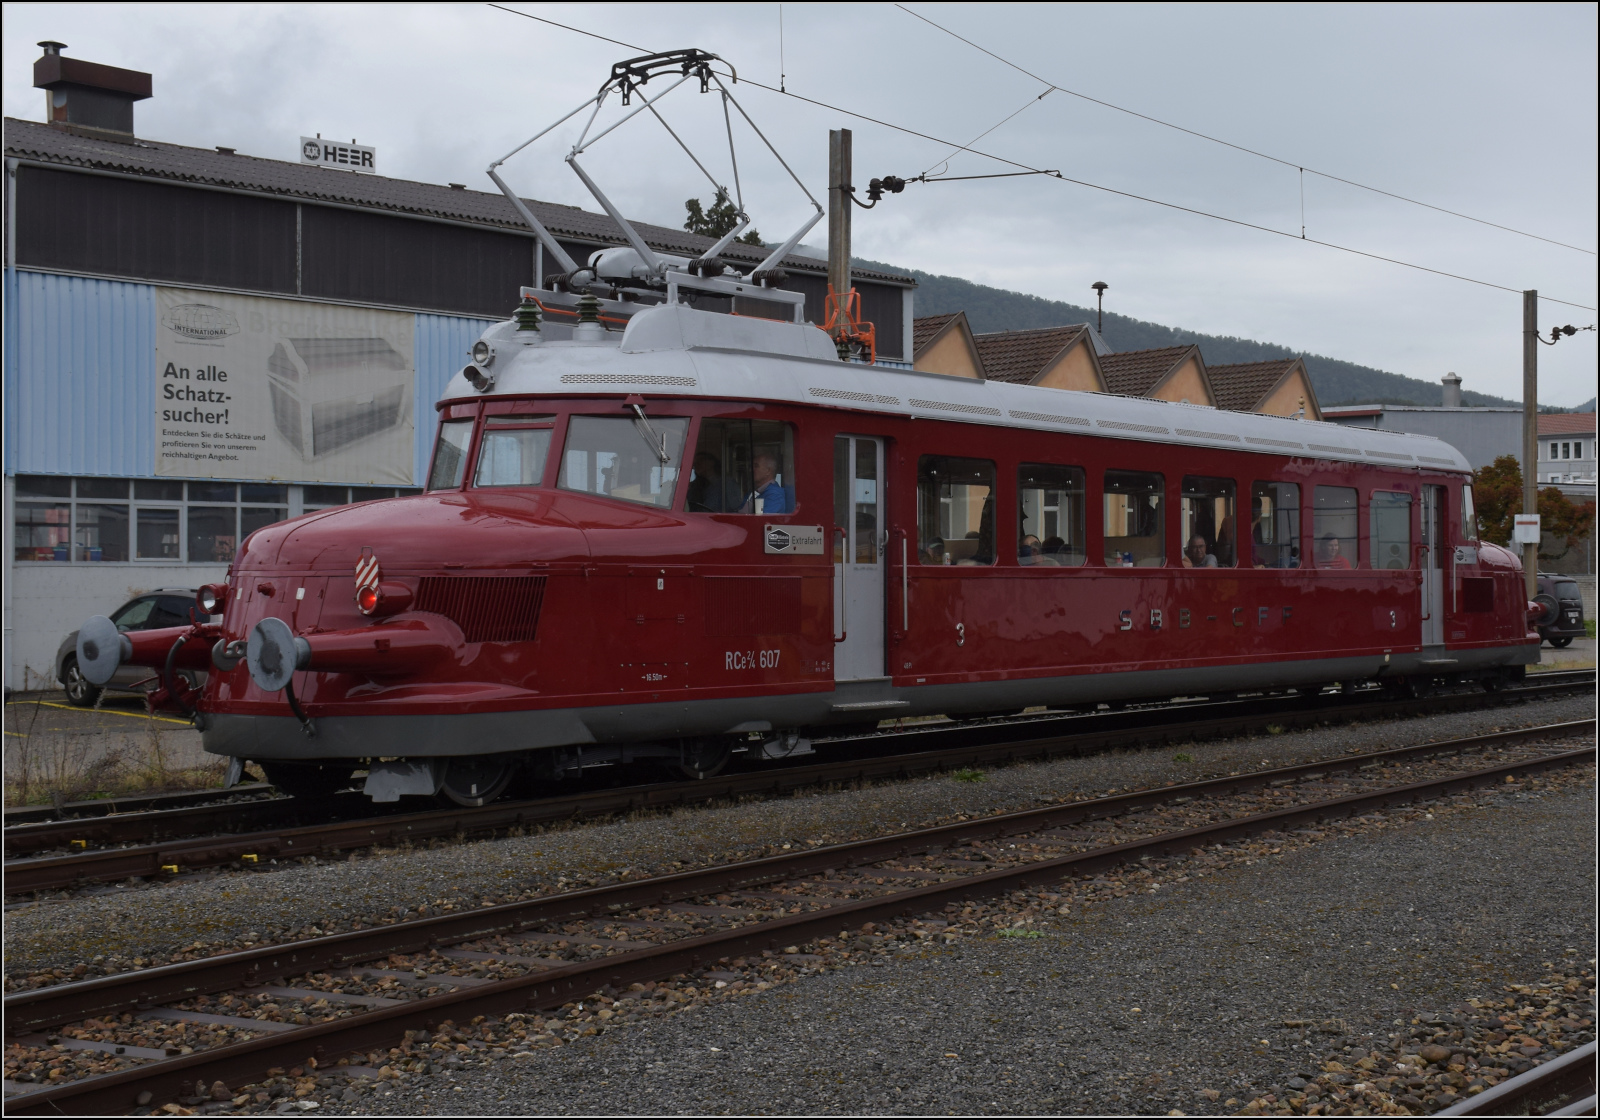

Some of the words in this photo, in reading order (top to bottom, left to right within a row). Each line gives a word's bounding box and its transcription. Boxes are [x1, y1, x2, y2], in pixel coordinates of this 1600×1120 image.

[324, 145, 373, 168] HEER
[174, 325, 228, 336] INTERNATIONAL
[163, 362, 190, 380] An
[196, 365, 228, 382] alle
[163, 383, 231, 403] Schatz-
[163, 407, 229, 425] sucher!
[162, 429, 199, 438] Entdecken
[225, 433, 251, 441] Schätze
[162, 440, 199, 449] profitieren
[162, 451, 207, 461] reichhaltigen
[208, 453, 239, 462] Angebot.
[791, 535, 822, 545] Extrafahrt
[956, 622, 965, 647] 3
[759, 649, 781, 669] 607
